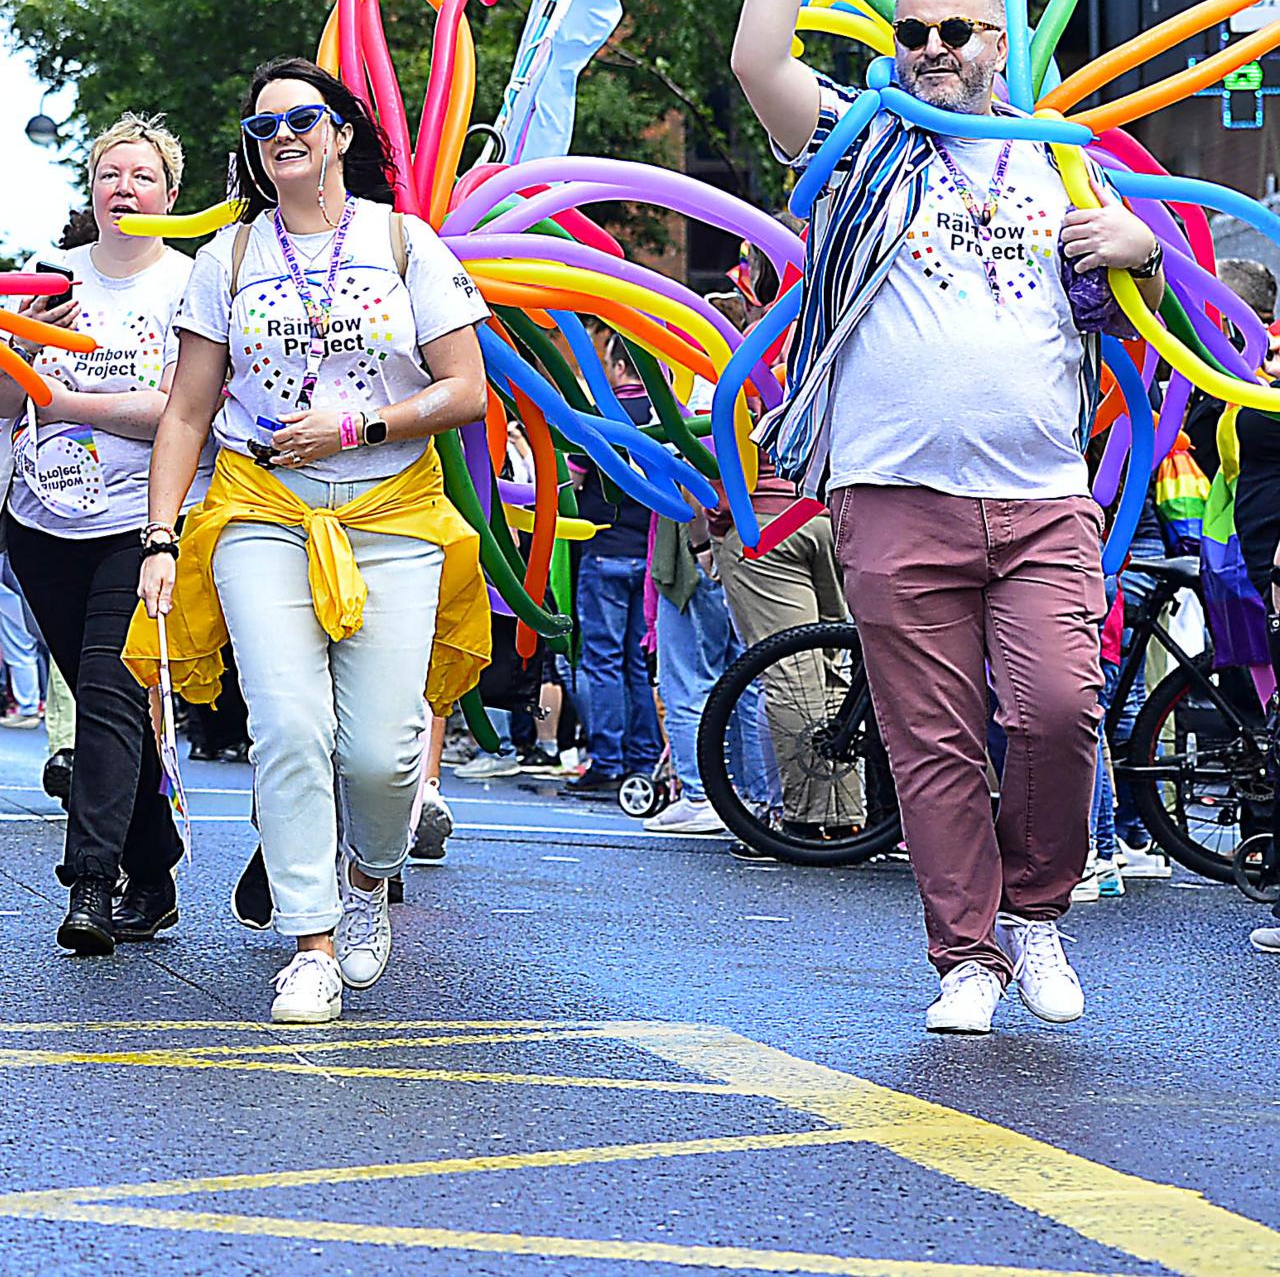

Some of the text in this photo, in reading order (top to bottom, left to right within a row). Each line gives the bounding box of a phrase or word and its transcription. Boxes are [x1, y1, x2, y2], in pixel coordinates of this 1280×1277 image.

[937, 212, 1026, 240] Rainow
[951, 233, 1026, 261] Proect
[284, 333, 365, 359] Prject
[73, 361, 138, 380] Project
